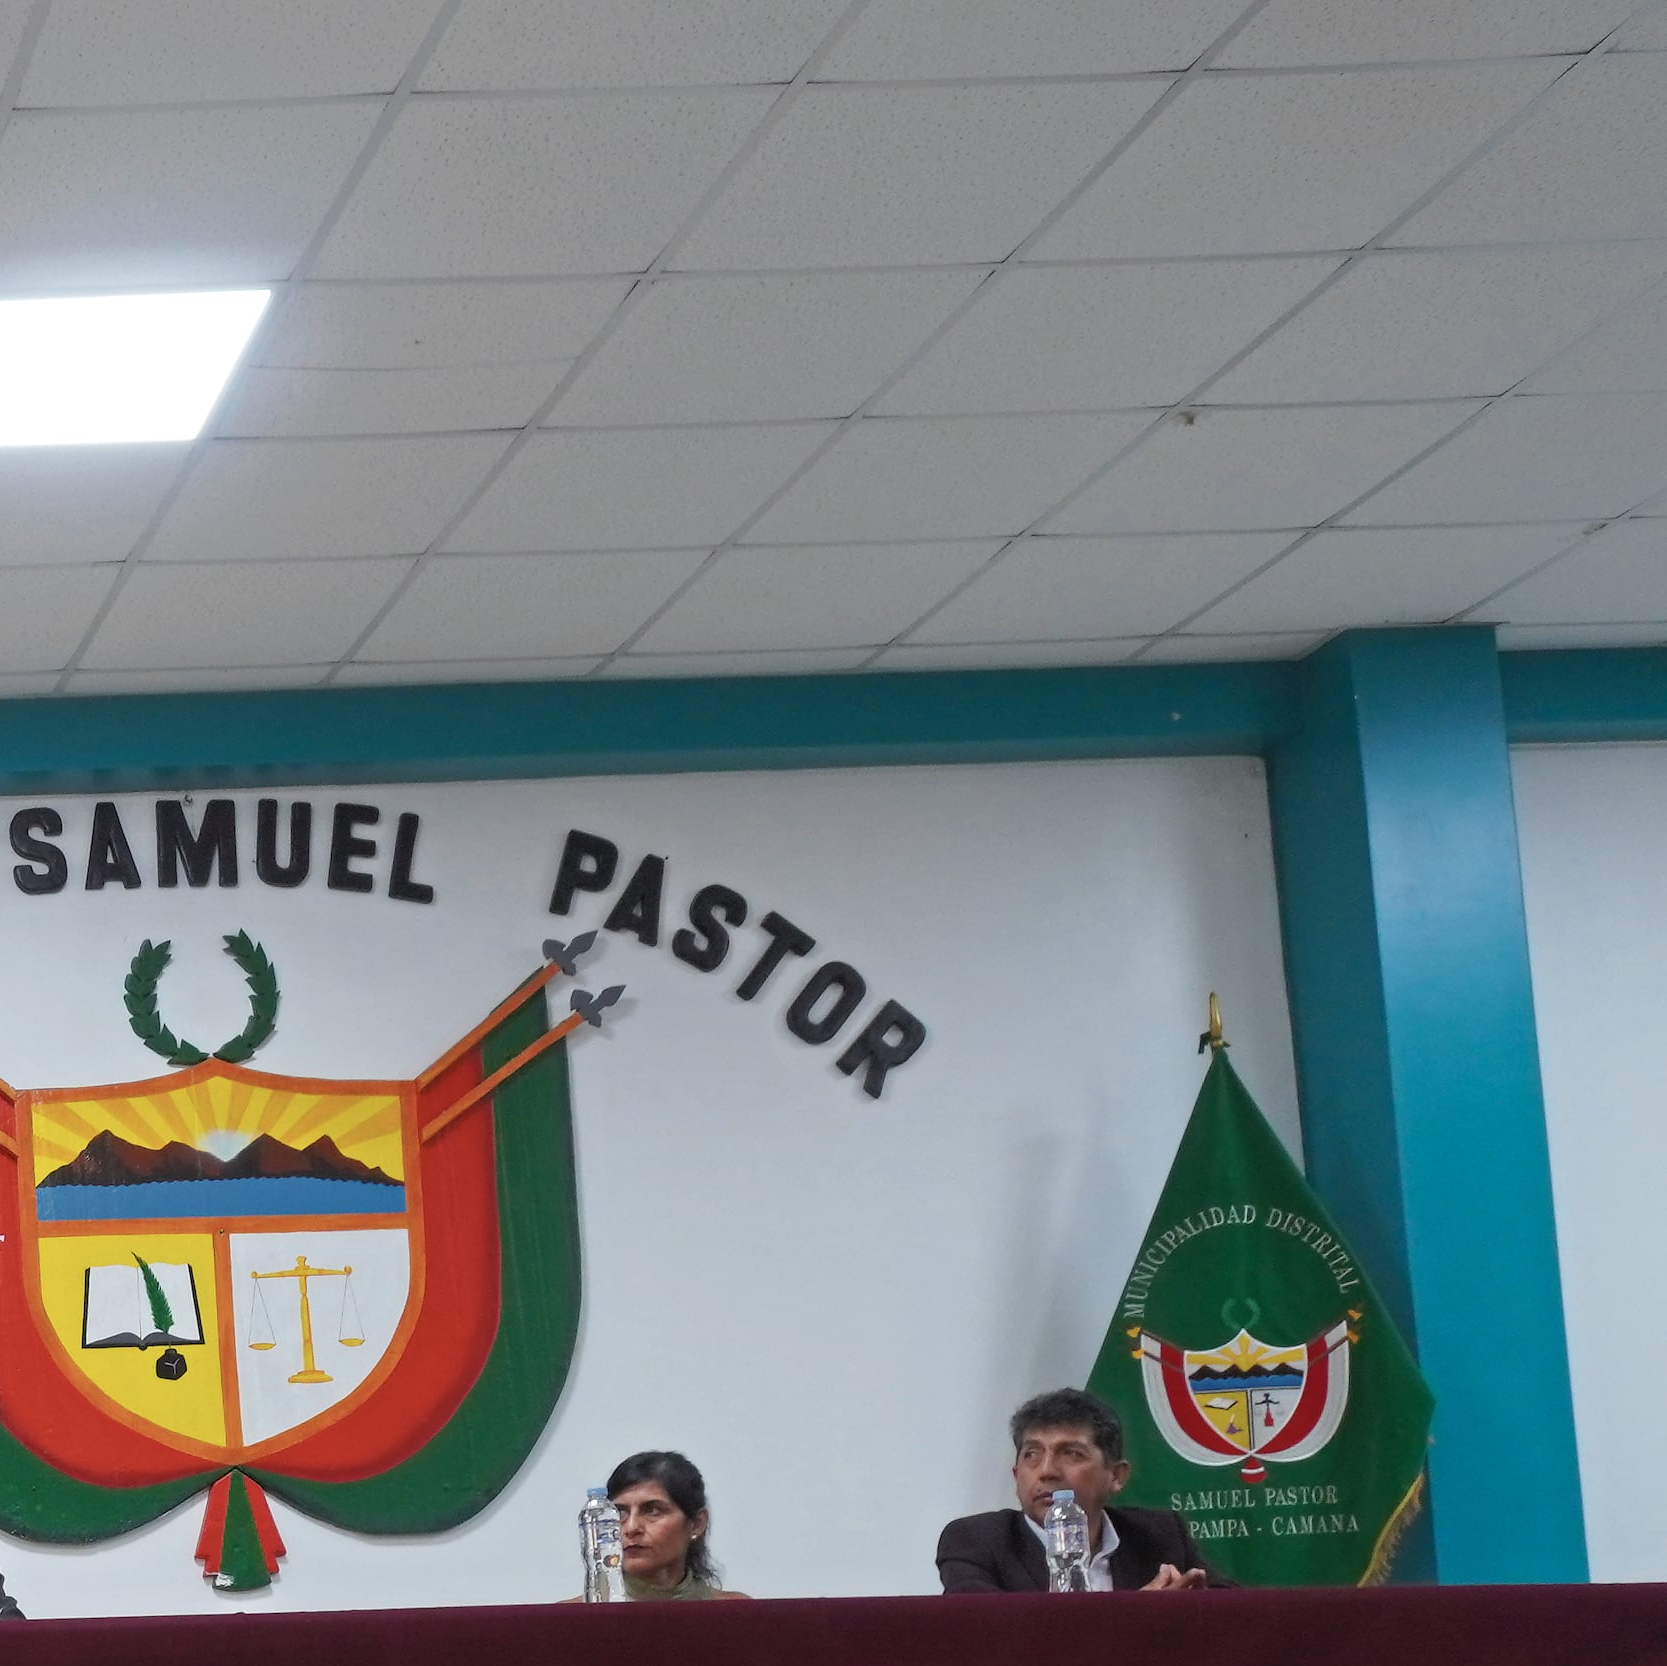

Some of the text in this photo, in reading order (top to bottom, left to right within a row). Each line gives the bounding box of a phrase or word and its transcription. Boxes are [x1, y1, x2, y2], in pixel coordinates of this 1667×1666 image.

[7, 797, 436, 906] SAMUEL
[547, 828, 927, 1102] PASTOR
[1123, 1204, 1361, 1319] MUNICIPALIDAD DISTRITAL
[1170, 1484, 1340, 1512] SAMUEL PASTOR
[1189, 1518, 1250, 1539] PAMPA
[1271, 1514, 1360, 1536] CAMANA
